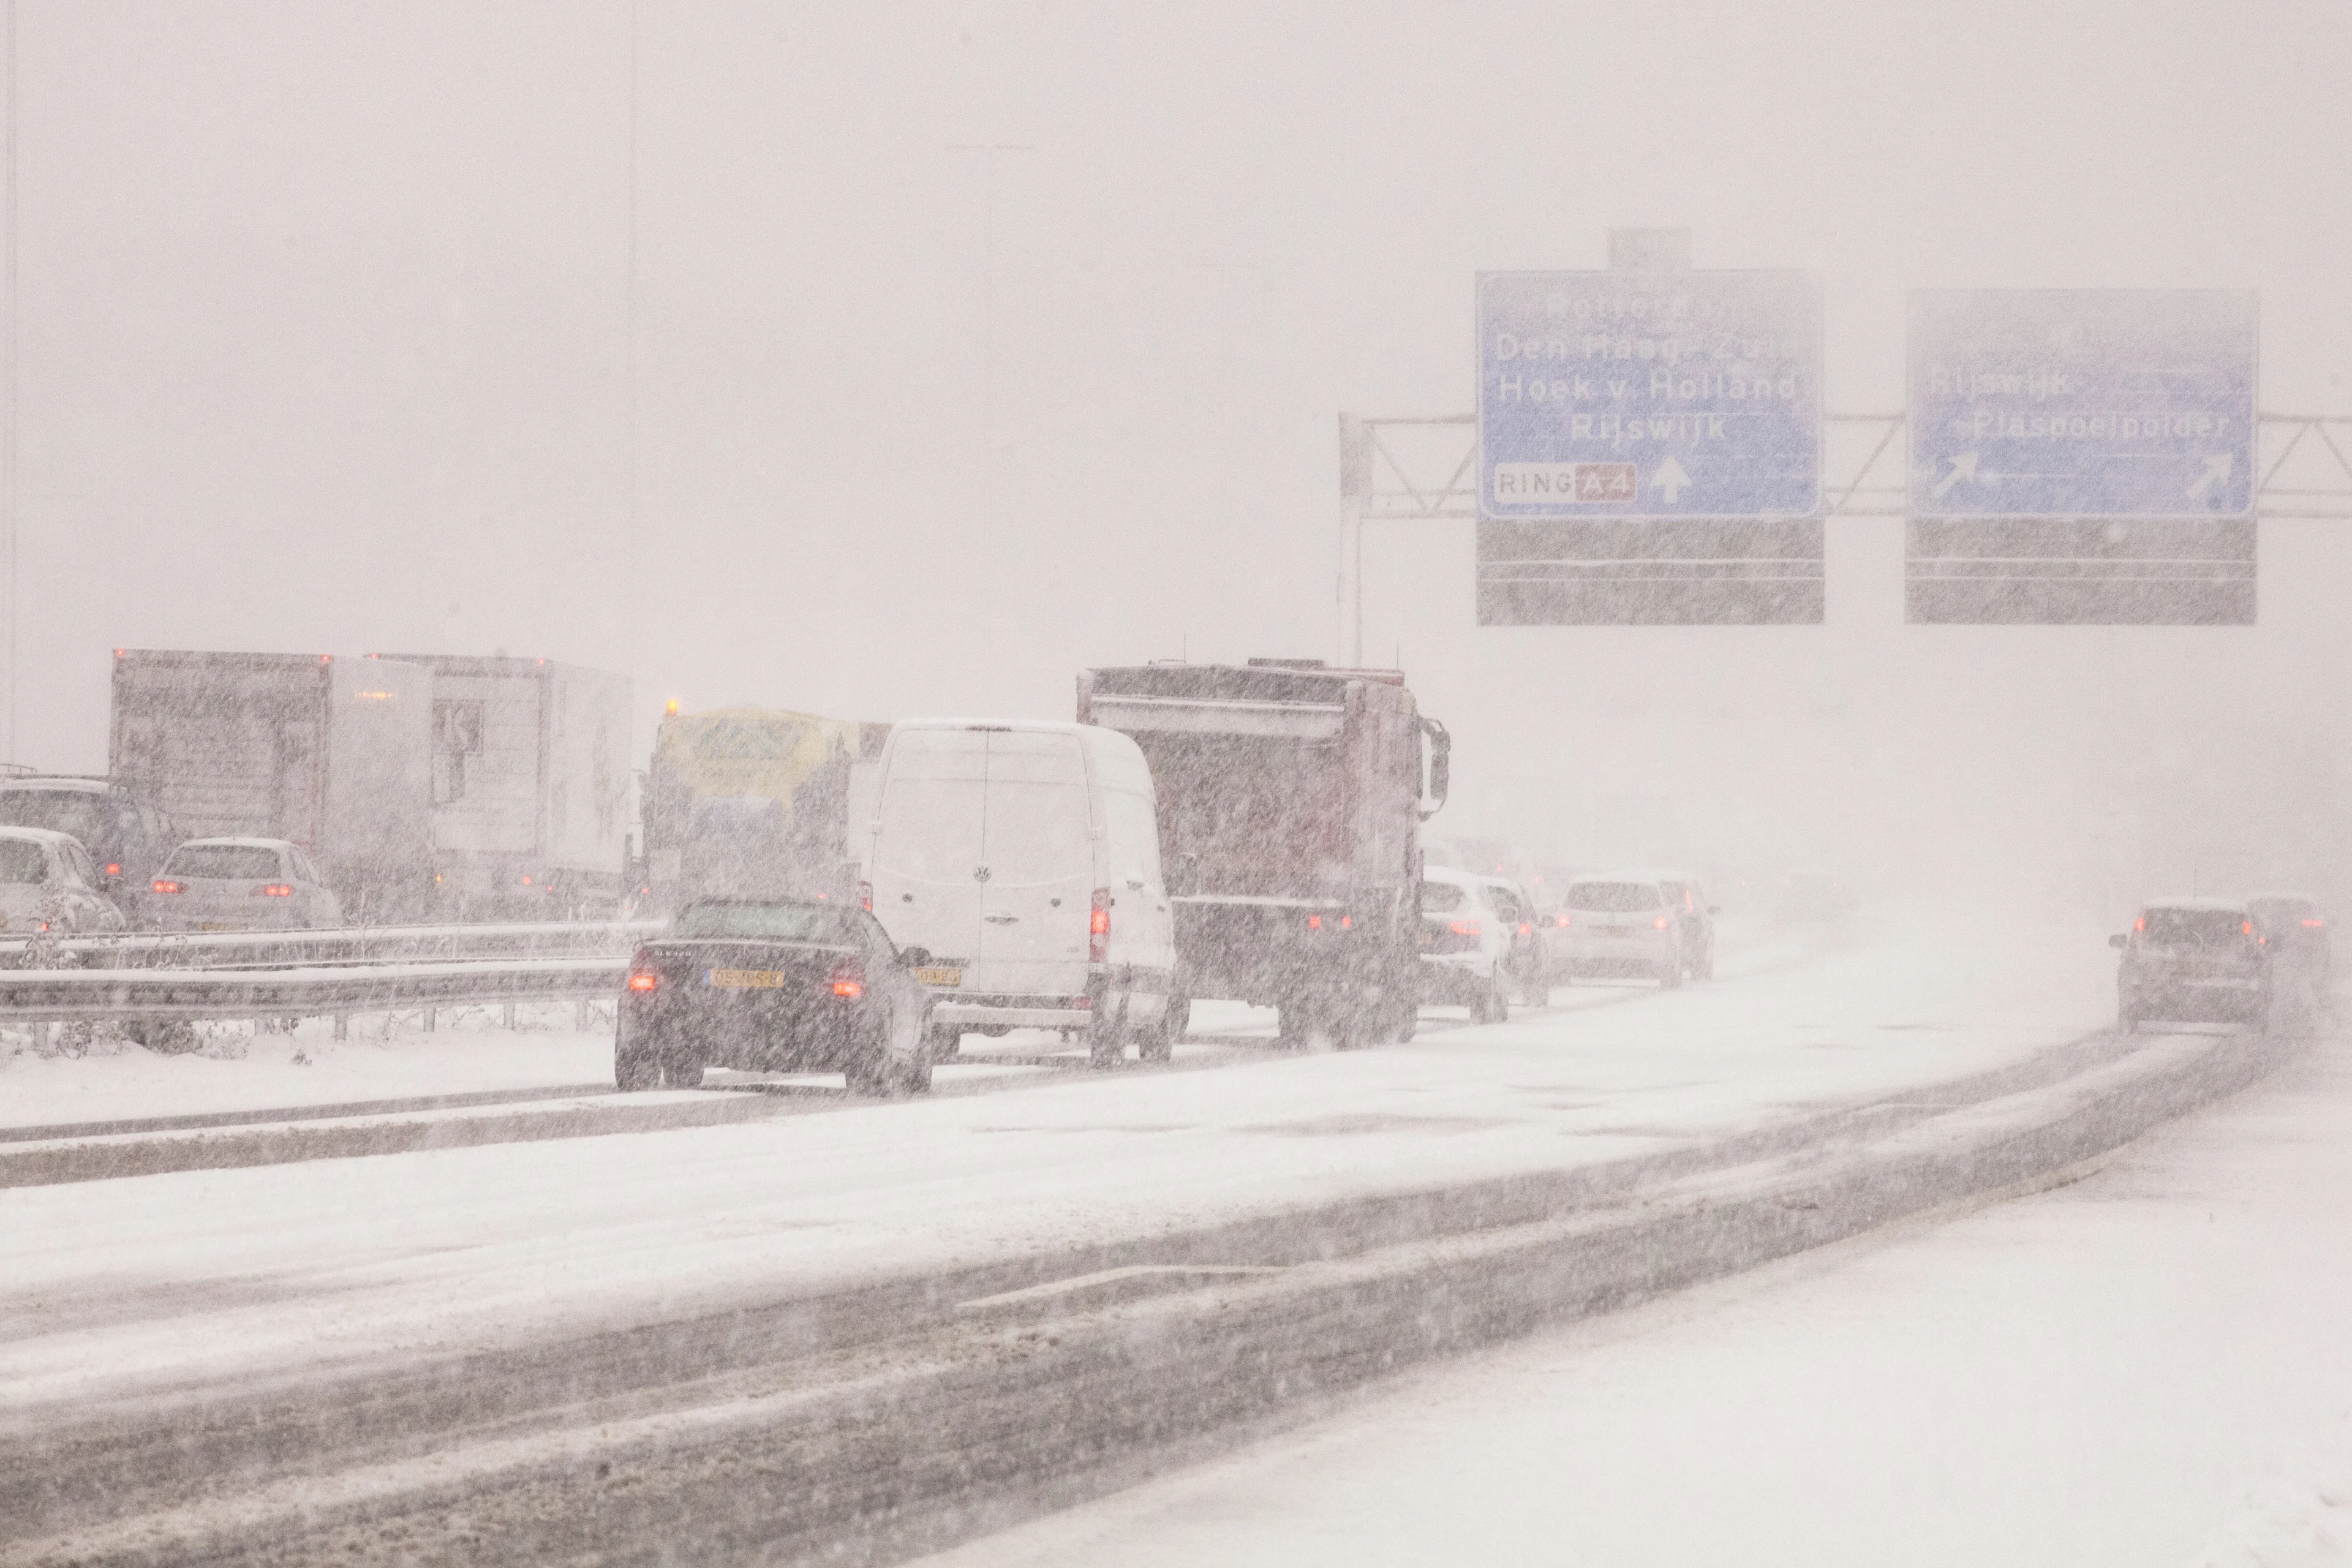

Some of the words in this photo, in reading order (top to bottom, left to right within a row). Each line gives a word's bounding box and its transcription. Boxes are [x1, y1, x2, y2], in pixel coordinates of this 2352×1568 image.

[1496, 332, 1568, 361] Den
[1499, 373, 1591, 401] Hoek
[1650, 372, 1796, 400] Holland
[1571, 413, 1726, 448] Rijswijk
[1499, 472, 1572, 494] RING
[1581, 472, 1630, 494] A4
